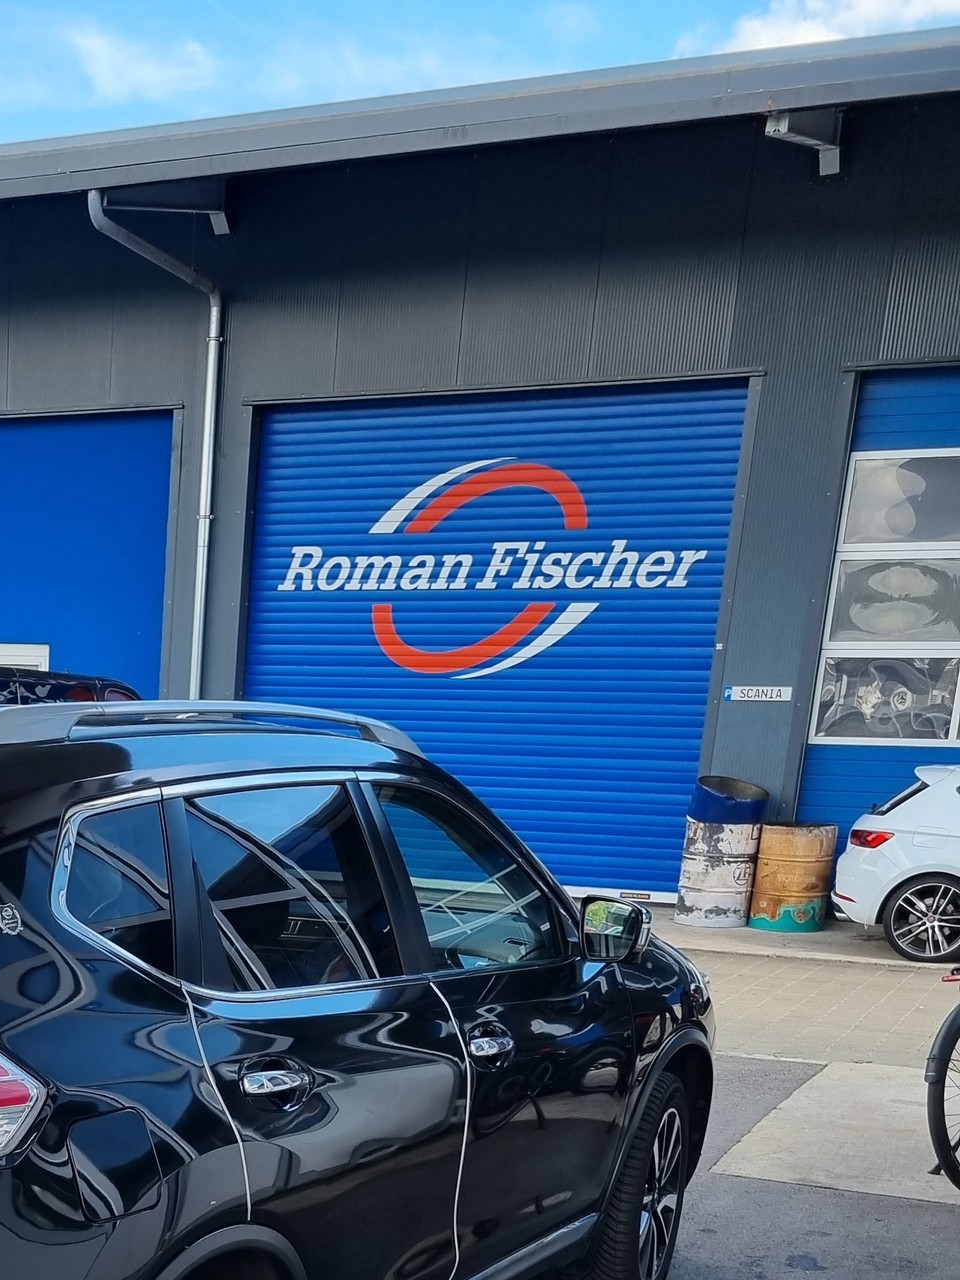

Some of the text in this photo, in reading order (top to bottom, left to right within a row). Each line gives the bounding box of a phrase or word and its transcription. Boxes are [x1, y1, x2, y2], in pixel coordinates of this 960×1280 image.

[277, 539, 708, 591] Roman Fischer
[740, 688, 782, 699] SCANIA
